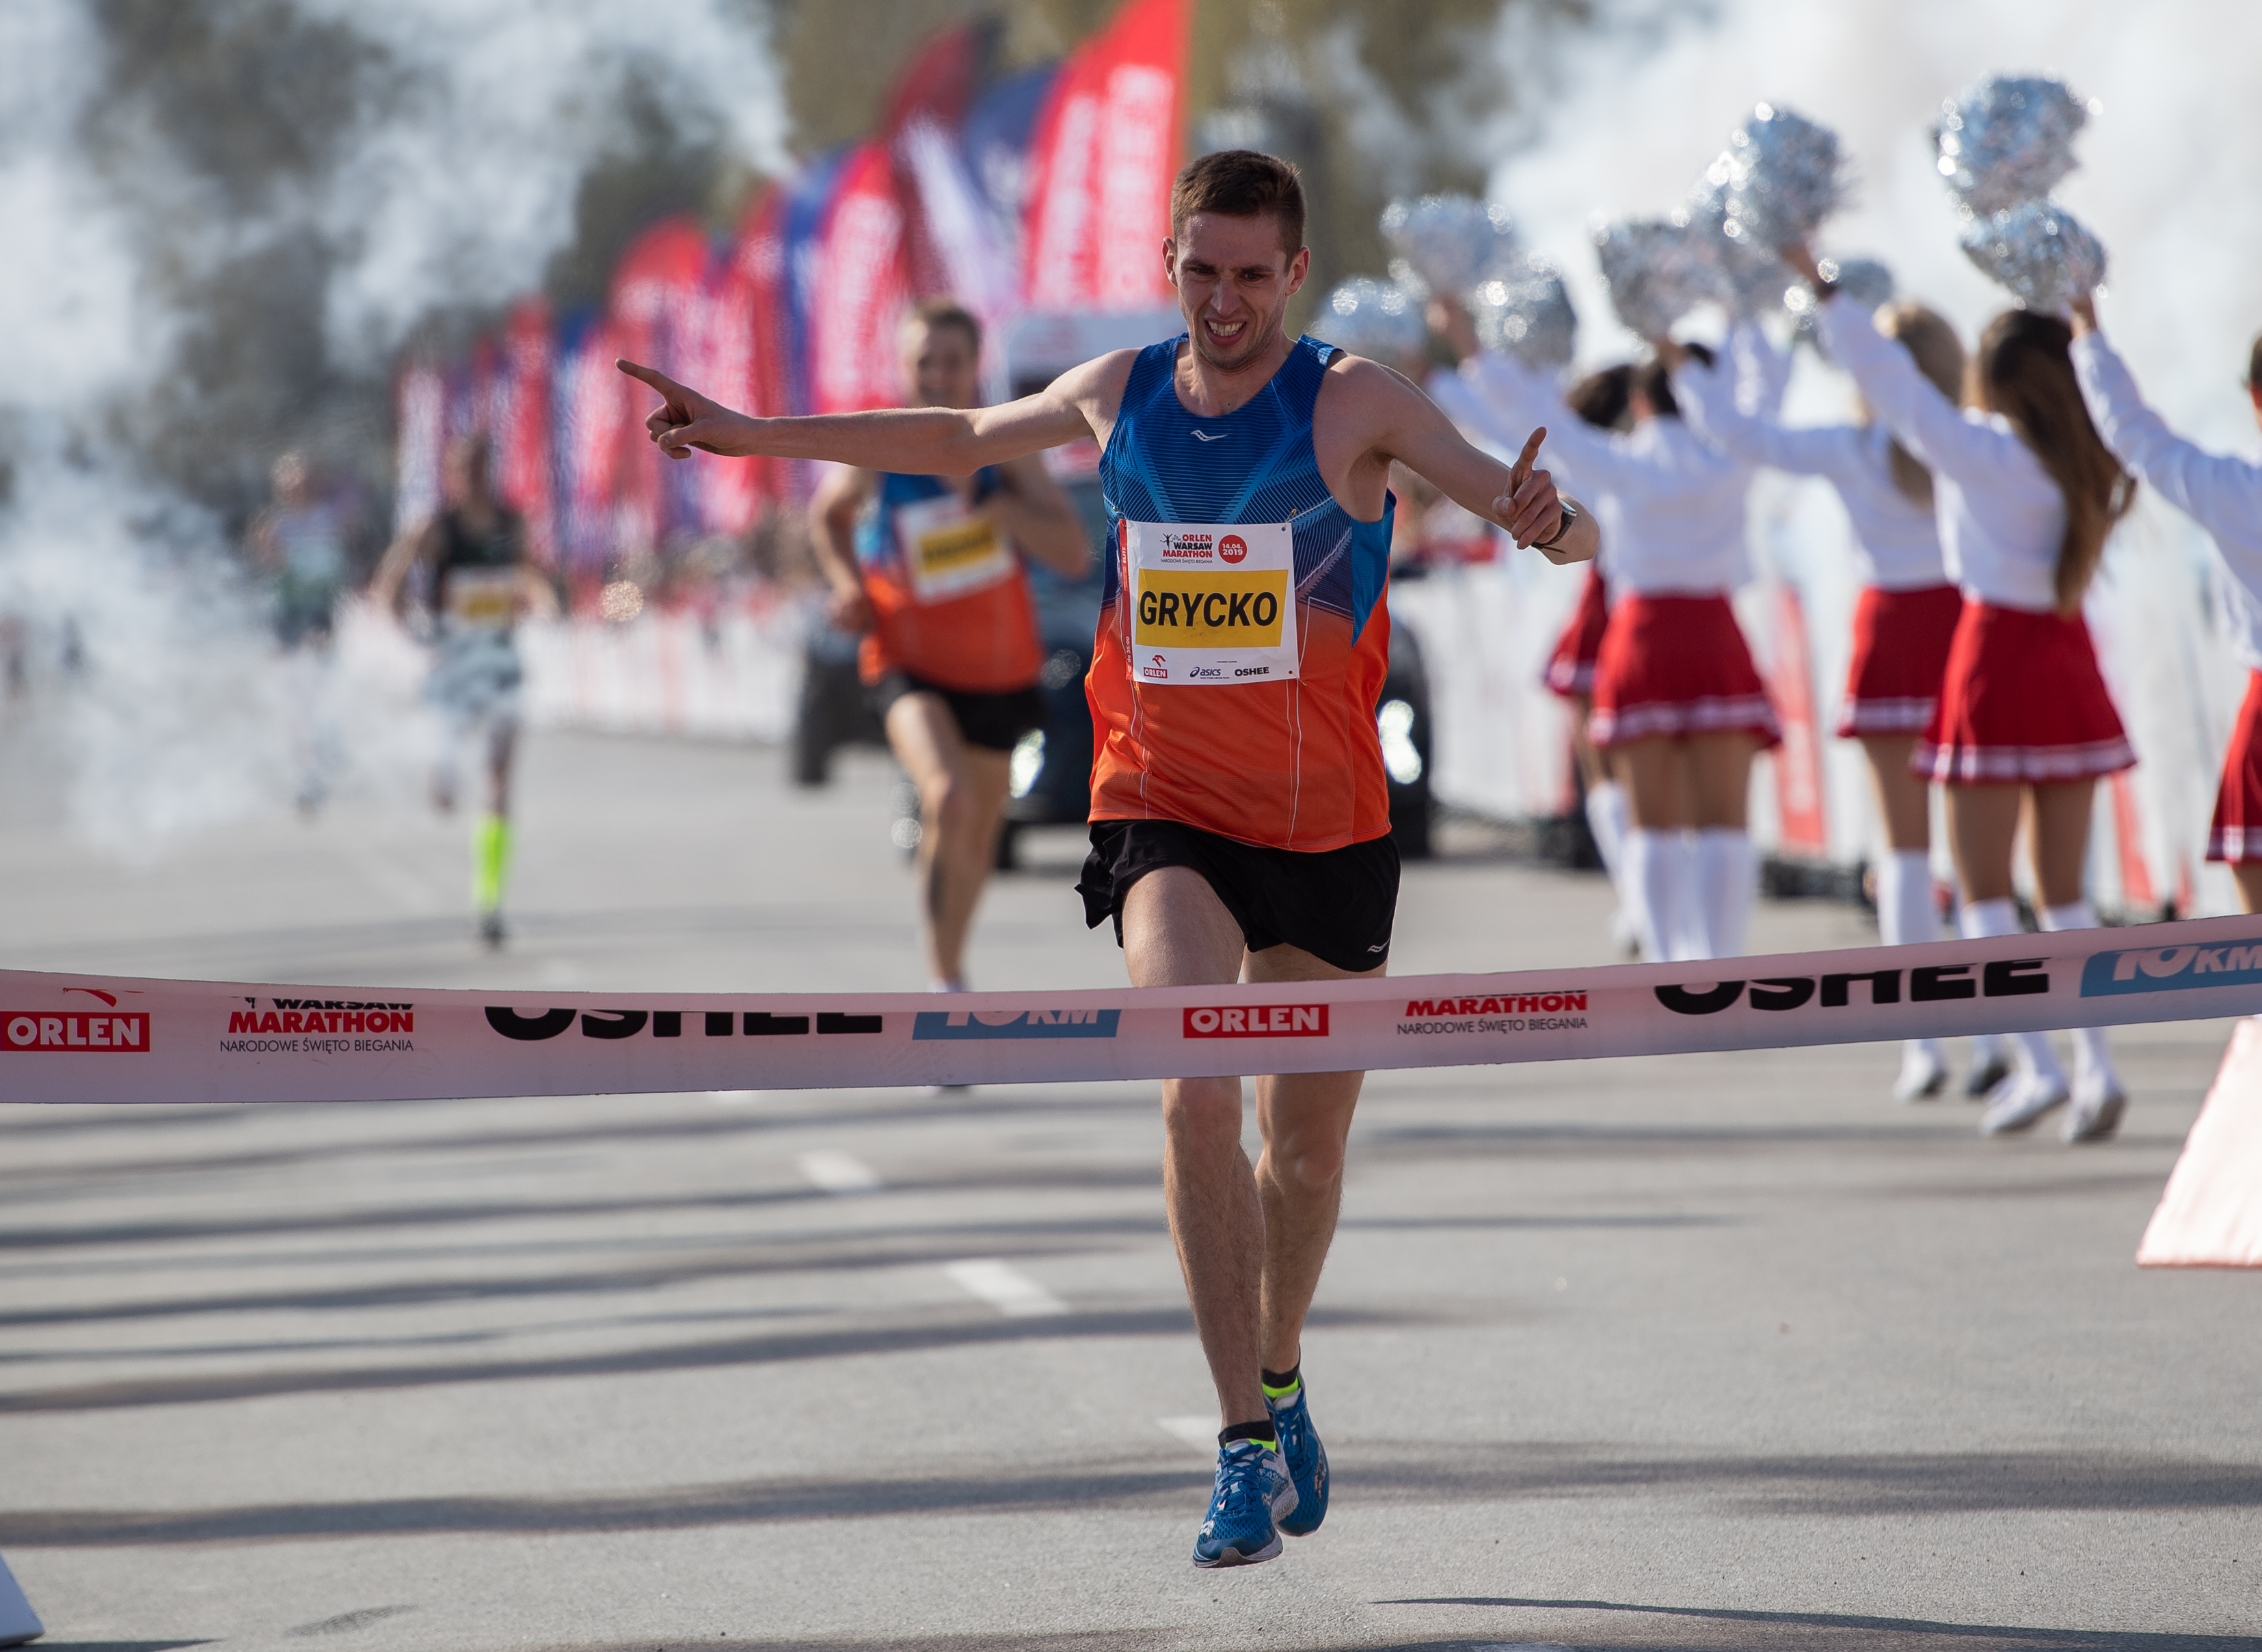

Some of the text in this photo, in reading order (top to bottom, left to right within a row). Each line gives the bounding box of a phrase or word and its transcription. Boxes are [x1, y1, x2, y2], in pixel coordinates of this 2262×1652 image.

[1182, 534, 1212, 542] ORLEN
[1163, 550, 1213, 558] MARATHON
[1140, 590, 1278, 627] GRYCKO
[1144, 669, 1166, 678] ORLEN
[1235, 666, 1270, 677] OSHEE
[1405, 994, 1587, 1016] MARATHON
[228, 1011, 414, 1033] MARATHON
[1190, 1007, 1319, 1033] ORLEN
[1397, 1017, 1588, 1035] NARODOWE ŚWIĘTO BIEGANIA
[7, 1016, 140, 1046] ORLEN
[219, 1037, 414, 1054] NARODOWE ŚWIĘTO BIEGANIA
